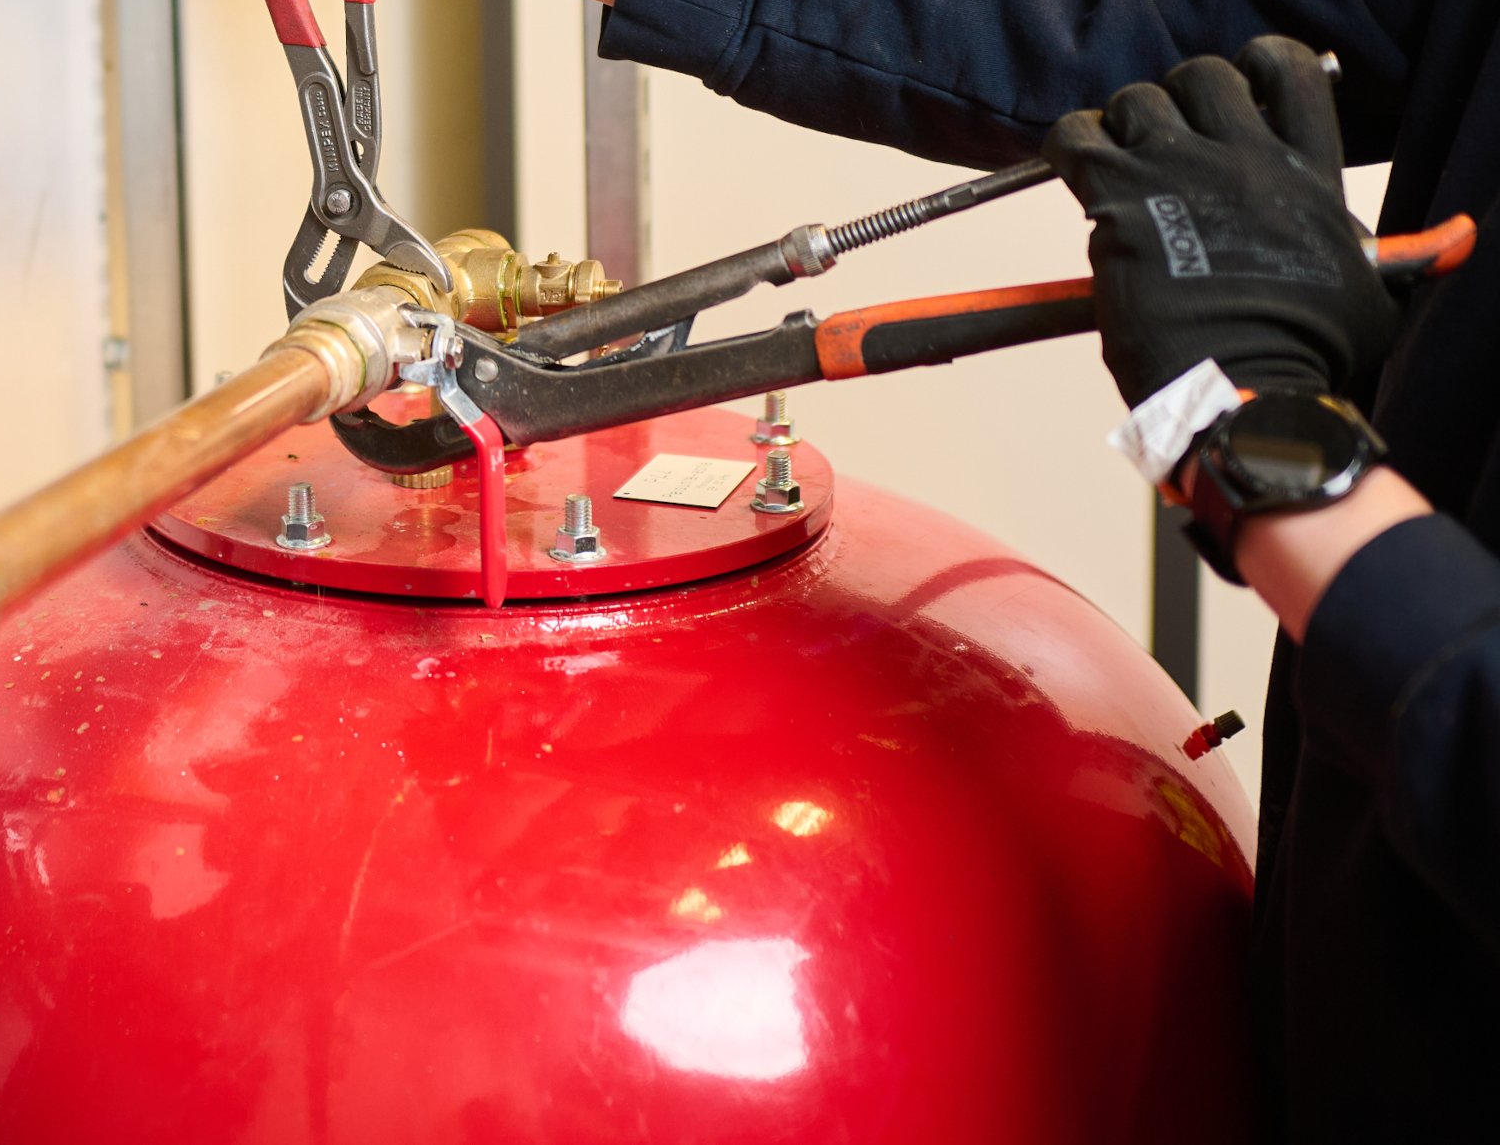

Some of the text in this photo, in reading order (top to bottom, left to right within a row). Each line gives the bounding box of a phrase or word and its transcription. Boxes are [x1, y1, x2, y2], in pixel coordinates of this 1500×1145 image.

[355, 98, 364, 125] MADE
[364, 86, 372, 131] GERMANY
[318, 119, 339, 172] KNIPEX
